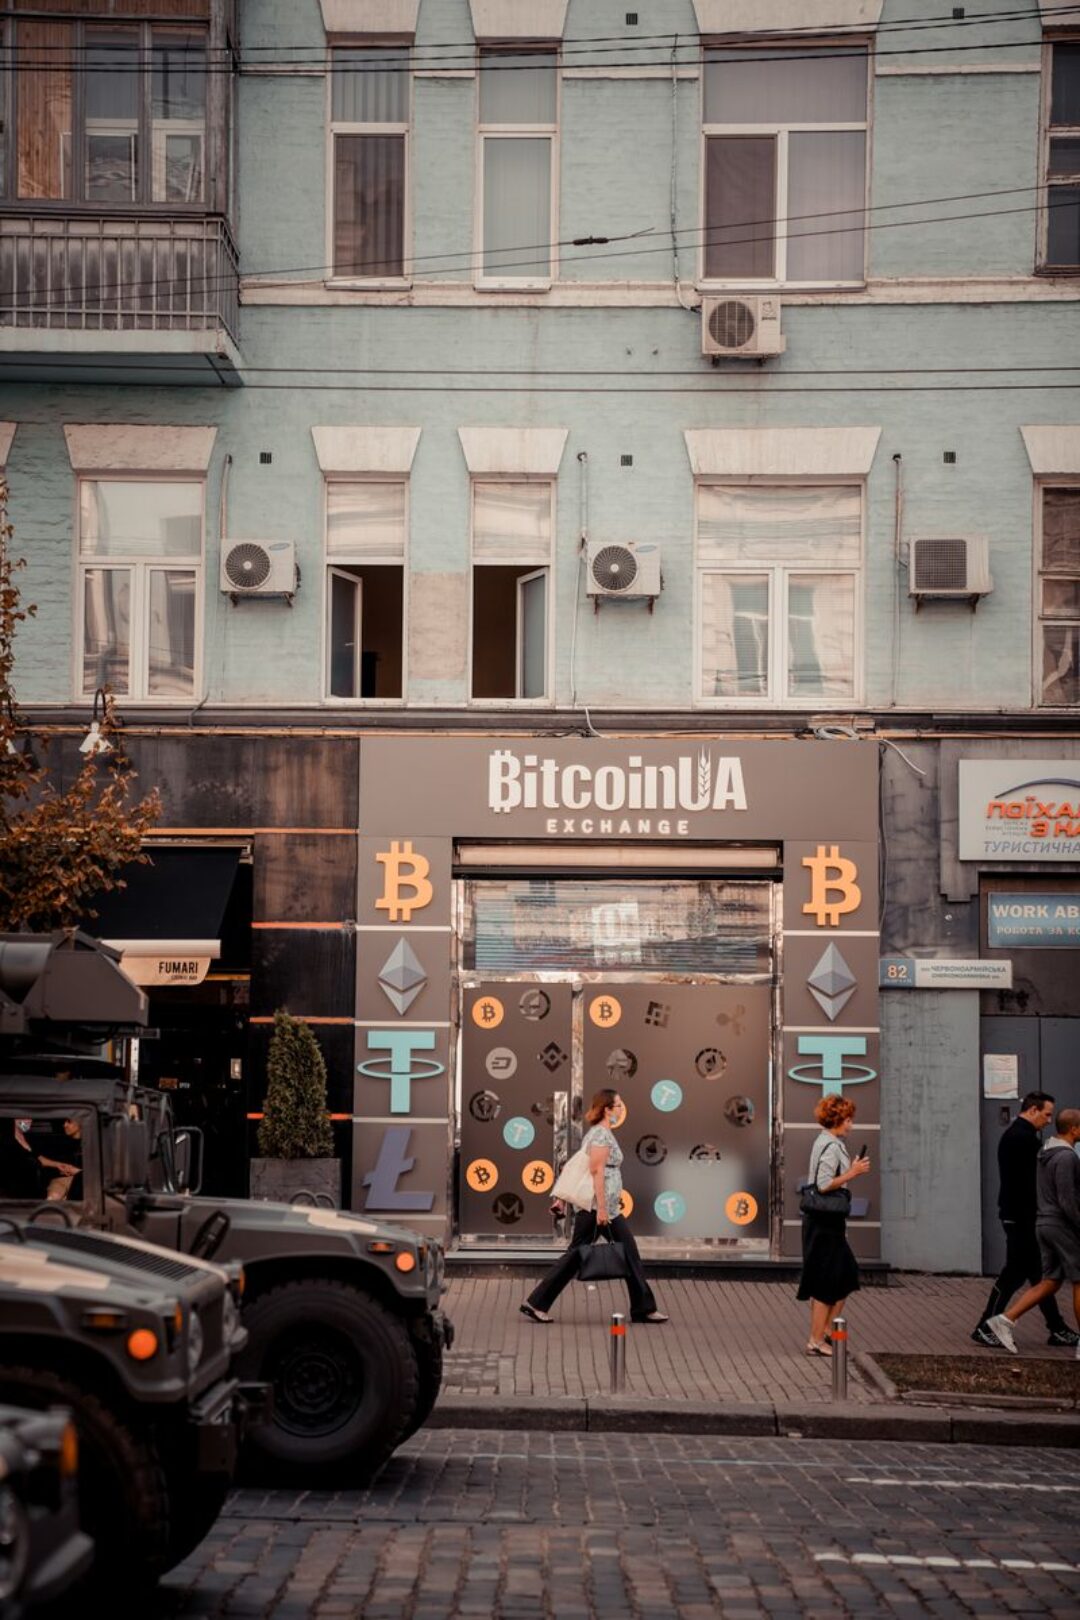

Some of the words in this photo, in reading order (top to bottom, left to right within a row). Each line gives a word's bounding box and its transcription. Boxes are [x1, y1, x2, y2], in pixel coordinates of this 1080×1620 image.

[546, 819, 690, 834] EXCHANGE
[992, 904, 1048, 918] WORK
[158, 961, 198, 974] FUMARI
[887, 965, 908, 978] 82
